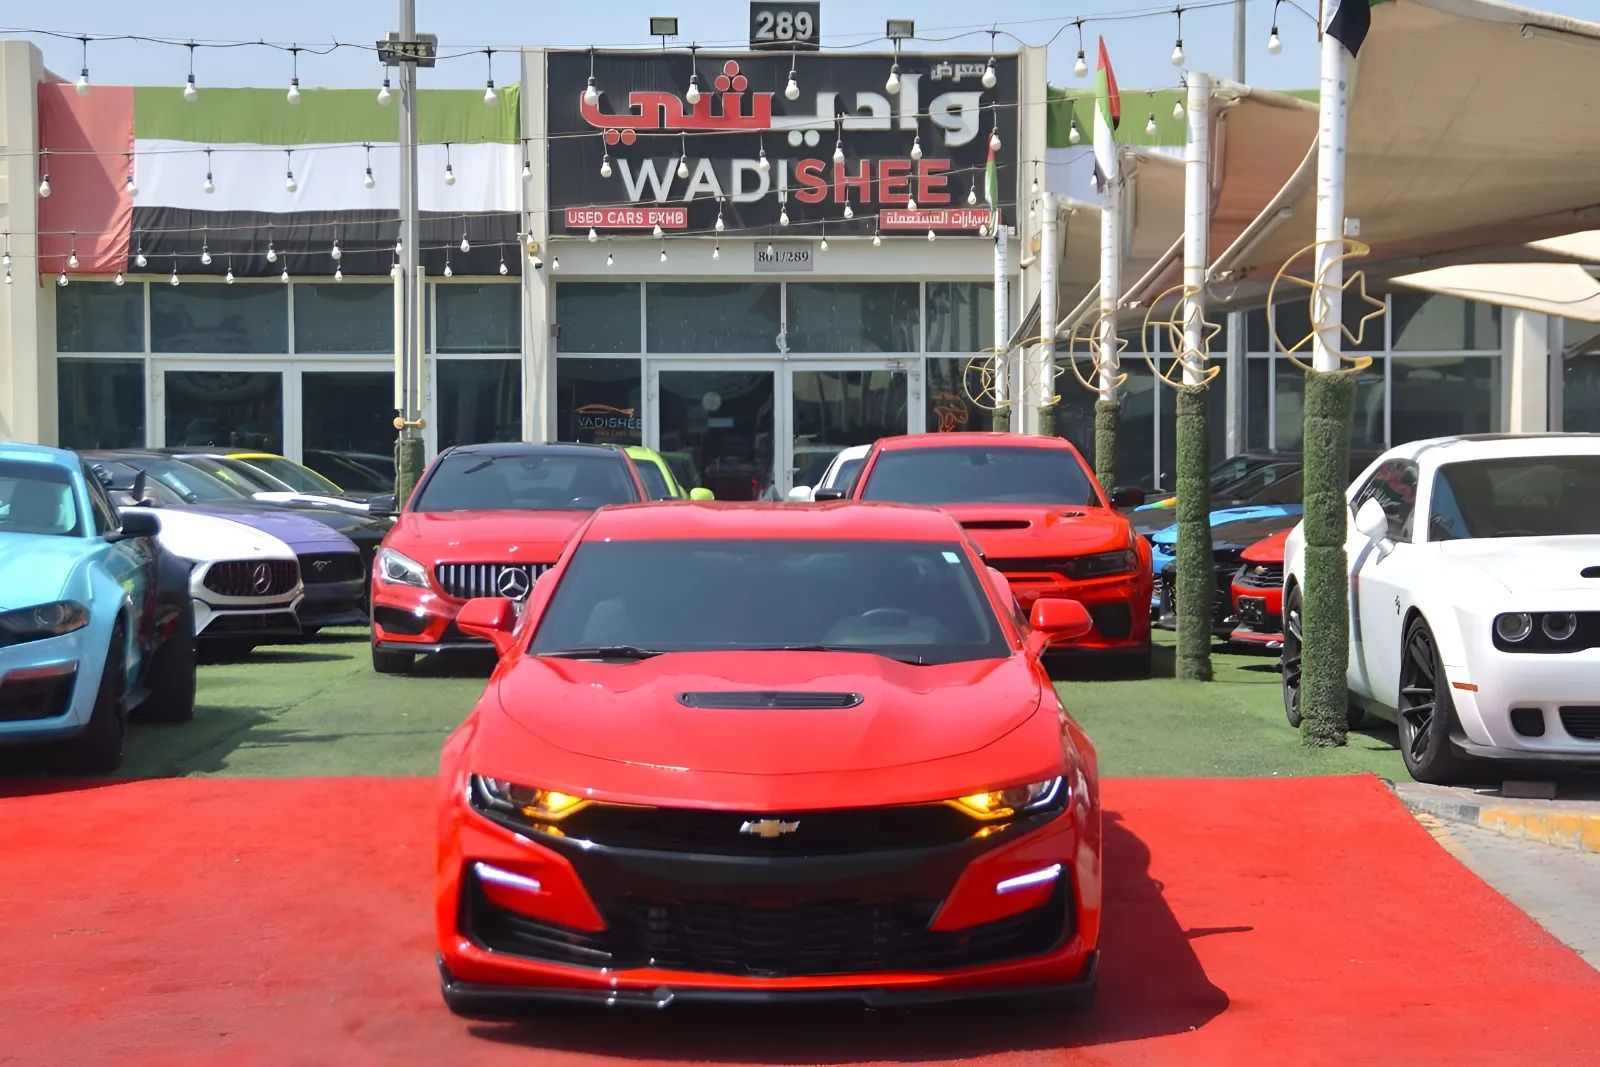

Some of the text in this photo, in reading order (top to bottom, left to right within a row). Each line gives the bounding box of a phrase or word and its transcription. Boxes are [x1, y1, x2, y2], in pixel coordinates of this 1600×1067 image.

[755, 10, 813, 40] 289
[616, 157, 951, 204] WADISHEE
[568, 211, 602, 224] USED
[607, 211, 643, 224] CARS
